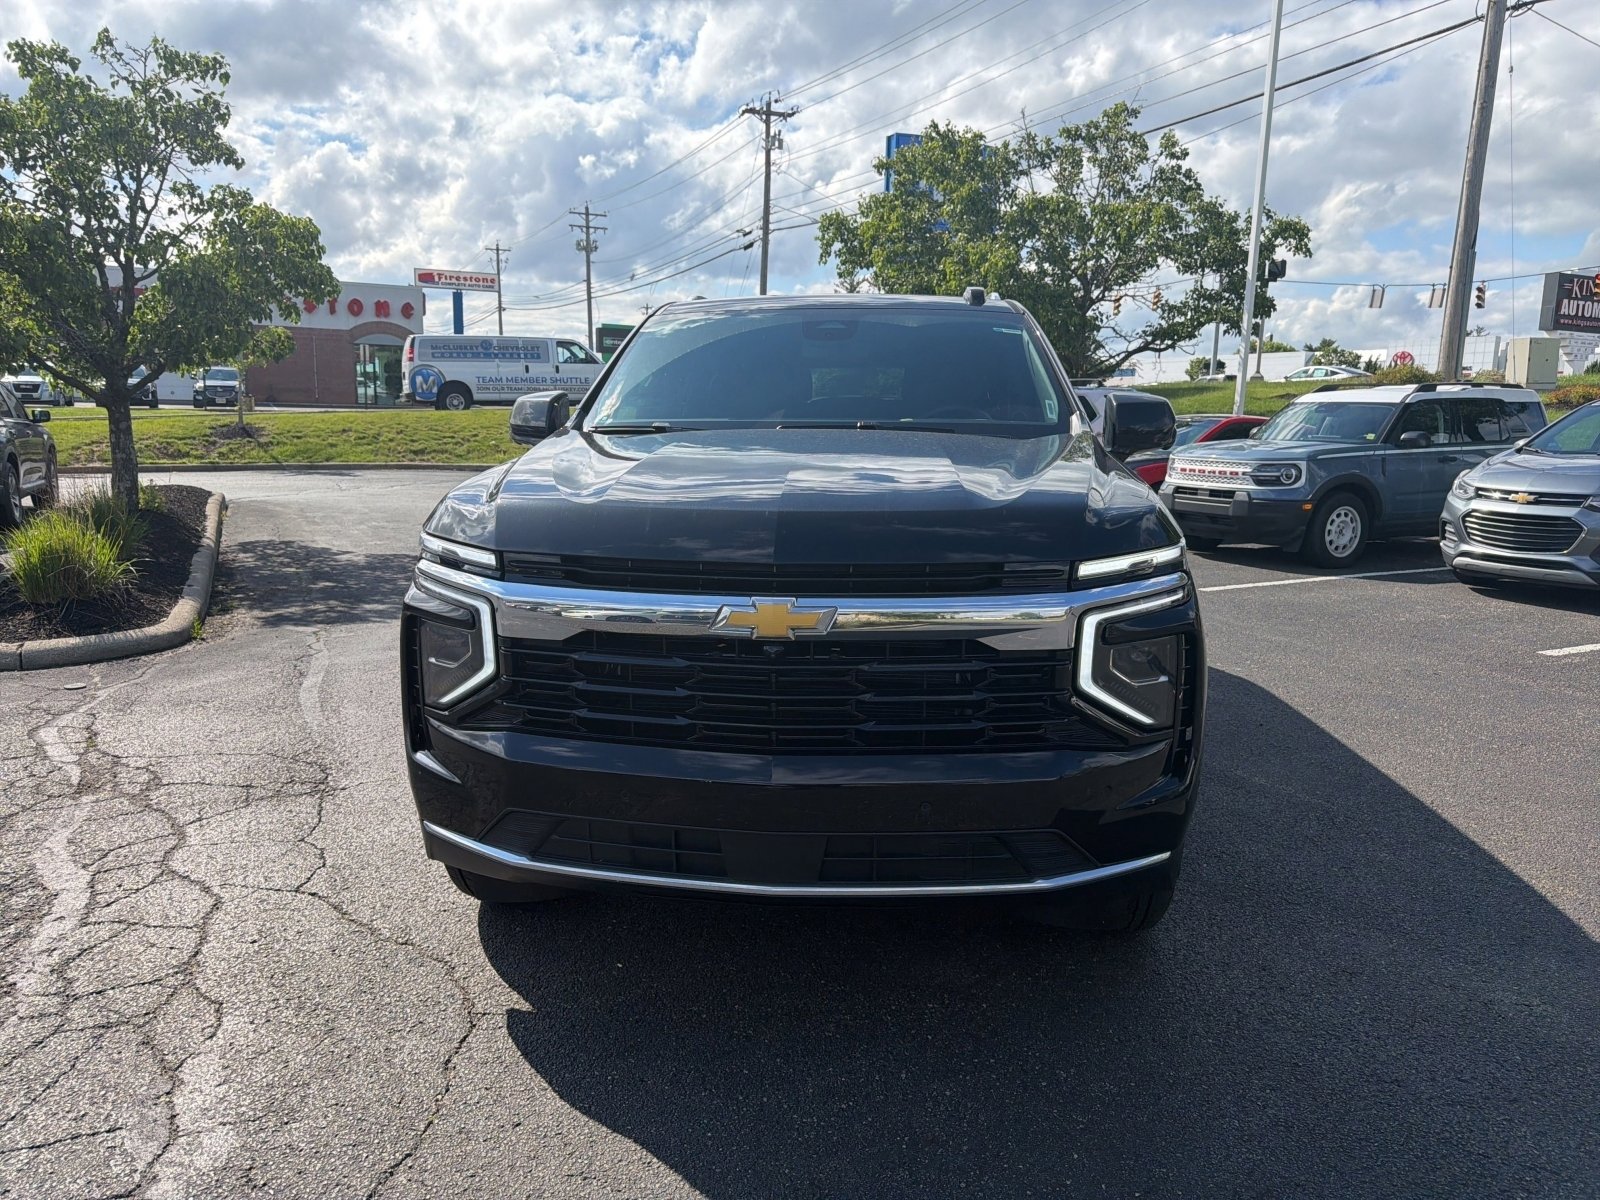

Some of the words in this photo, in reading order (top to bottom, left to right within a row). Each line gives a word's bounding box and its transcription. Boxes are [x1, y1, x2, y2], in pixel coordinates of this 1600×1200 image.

[436, 273, 496, 284] Firestone
[415, 375, 438, 393] M
[476, 376, 503, 384] TEAM
[505, 376, 546, 384] MEMBER
[549, 376, 591, 385] SHUTTLE
[1180, 467, 1239, 476] BRONCO
